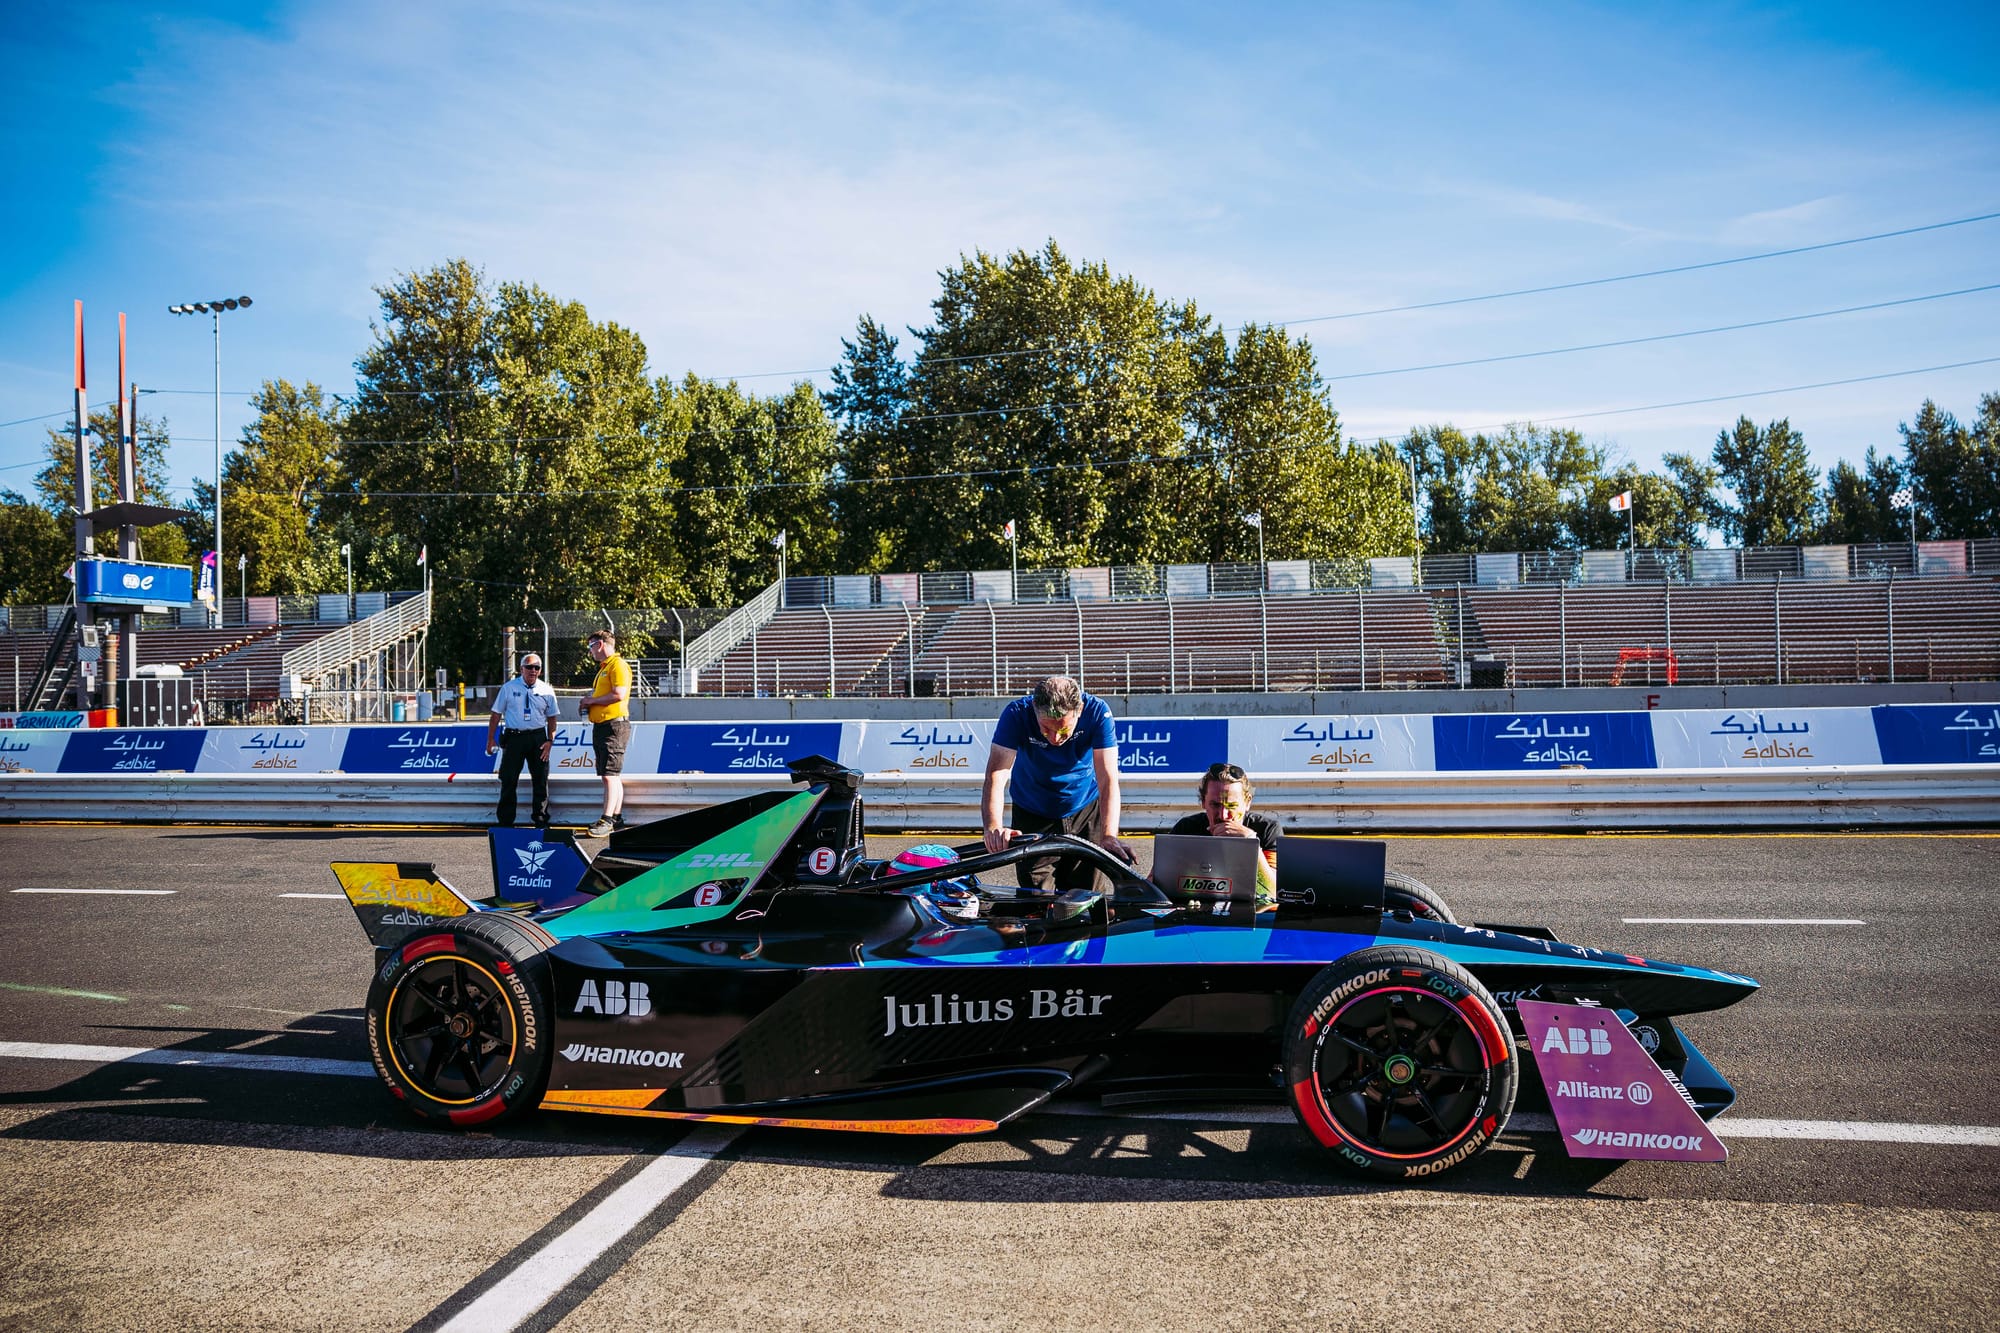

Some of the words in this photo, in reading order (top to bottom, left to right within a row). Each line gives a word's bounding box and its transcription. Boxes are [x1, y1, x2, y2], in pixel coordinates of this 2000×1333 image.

[1282, 722, 1373, 748] سابك
[1496, 718, 1590, 744] سابك
[1708, 714, 1809, 740] سابك
[104, 735, 165, 755] سابك
[240, 733, 305, 754] سابك
[388, 731, 456, 752] سابك
[711, 728, 790, 751] سابك
[889, 727, 973, 751] سابك
[1742, 739, 1814, 758] sabic
[112, 754, 156, 770] sabic
[252, 754, 297, 768] sabic
[400, 752, 449, 768] sabic
[728, 750, 785, 768] sabic
[910, 750, 969, 768] sabic
[1308, 746, 1374, 764] sabic
[1523, 743, 1592, 762] sabic
[687, 853, 753, 868] DHL
[816, 852, 829, 870] E
[508, 875, 552, 888] Saudia
[1183, 878, 1227, 891] MoTeC
[700, 889, 715, 905] E
[380, 908, 433, 926] sabic
[574, 979, 651, 1016] ABB
[884, 994, 1014, 1037] Julius
[1028, 989, 1113, 1019] Bär
[1542, 1027, 1612, 1056] ABB
[1556, 1081, 1624, 1100] Allianz
